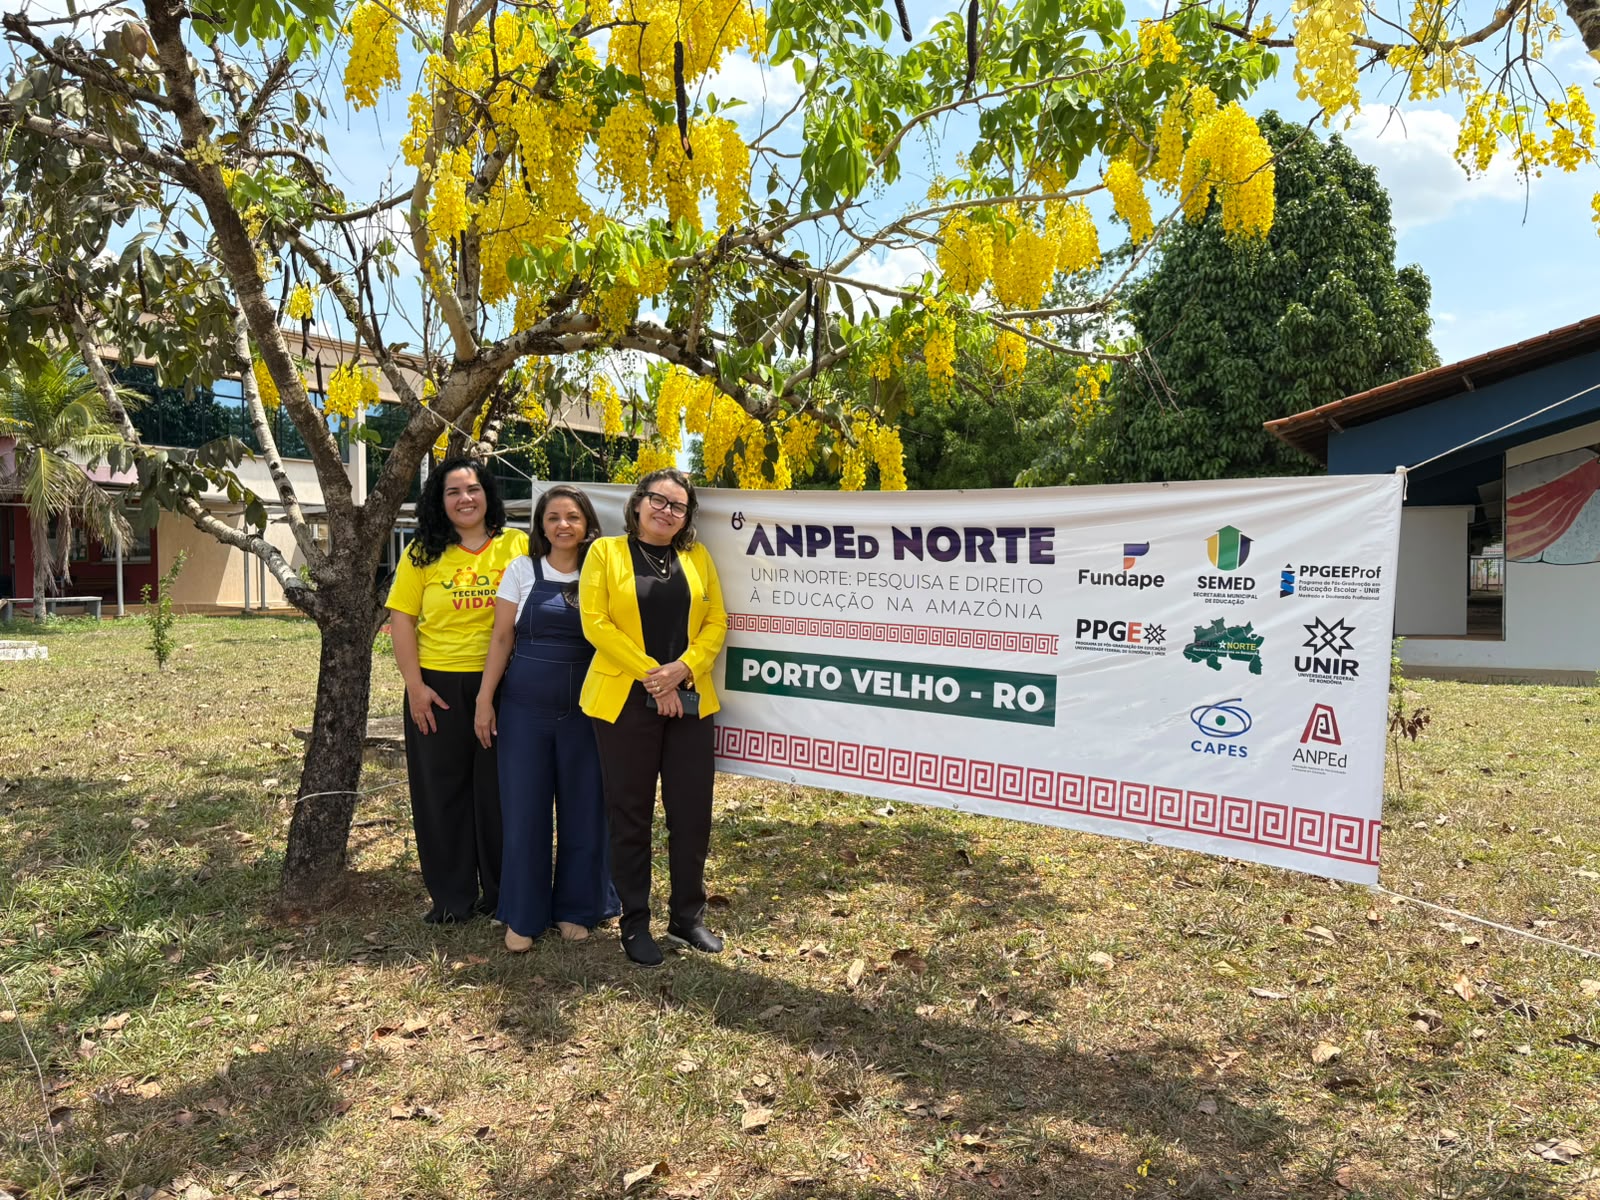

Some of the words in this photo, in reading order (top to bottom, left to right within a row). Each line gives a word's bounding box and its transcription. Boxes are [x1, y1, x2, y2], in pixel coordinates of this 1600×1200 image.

[891, 526, 1056, 564] NORTE
[751, 567, 789, 583] UNIR
[793, 569, 852, 586] NORTE:
[857, 571, 944, 590] PESQUISA
[949, 575, 959, 591] E
[966, 576, 1043, 594] DIREITO
[1078, 569, 1165, 590] Fundape
[1300, 565, 1382, 579] PPGEEProf
[452, 589, 497, 598] TECENDO
[1197, 575, 1256, 591] SEMED
[1298, 585, 1332, 593] Educação
[750, 587, 761, 603] À
[772, 590, 874, 612] EDUCAÇÃO
[887, 596, 914, 613] NA
[925, 598, 1043, 620] AMAZÔNIA
[1075, 618, 1142, 643] PPGE
[1226, 642, 1257, 651] NORTE
[1294, 655, 1360, 677] UNIR
[742, 658, 843, 691] PORTO
[850, 668, 961, 703] VELHO
[971, 690, 982, 699] -
[993, 681, 1045, 713] RO
[1191, 740, 1248, 758] CAPES
[1292, 747, 1348, 769] ANPEd
